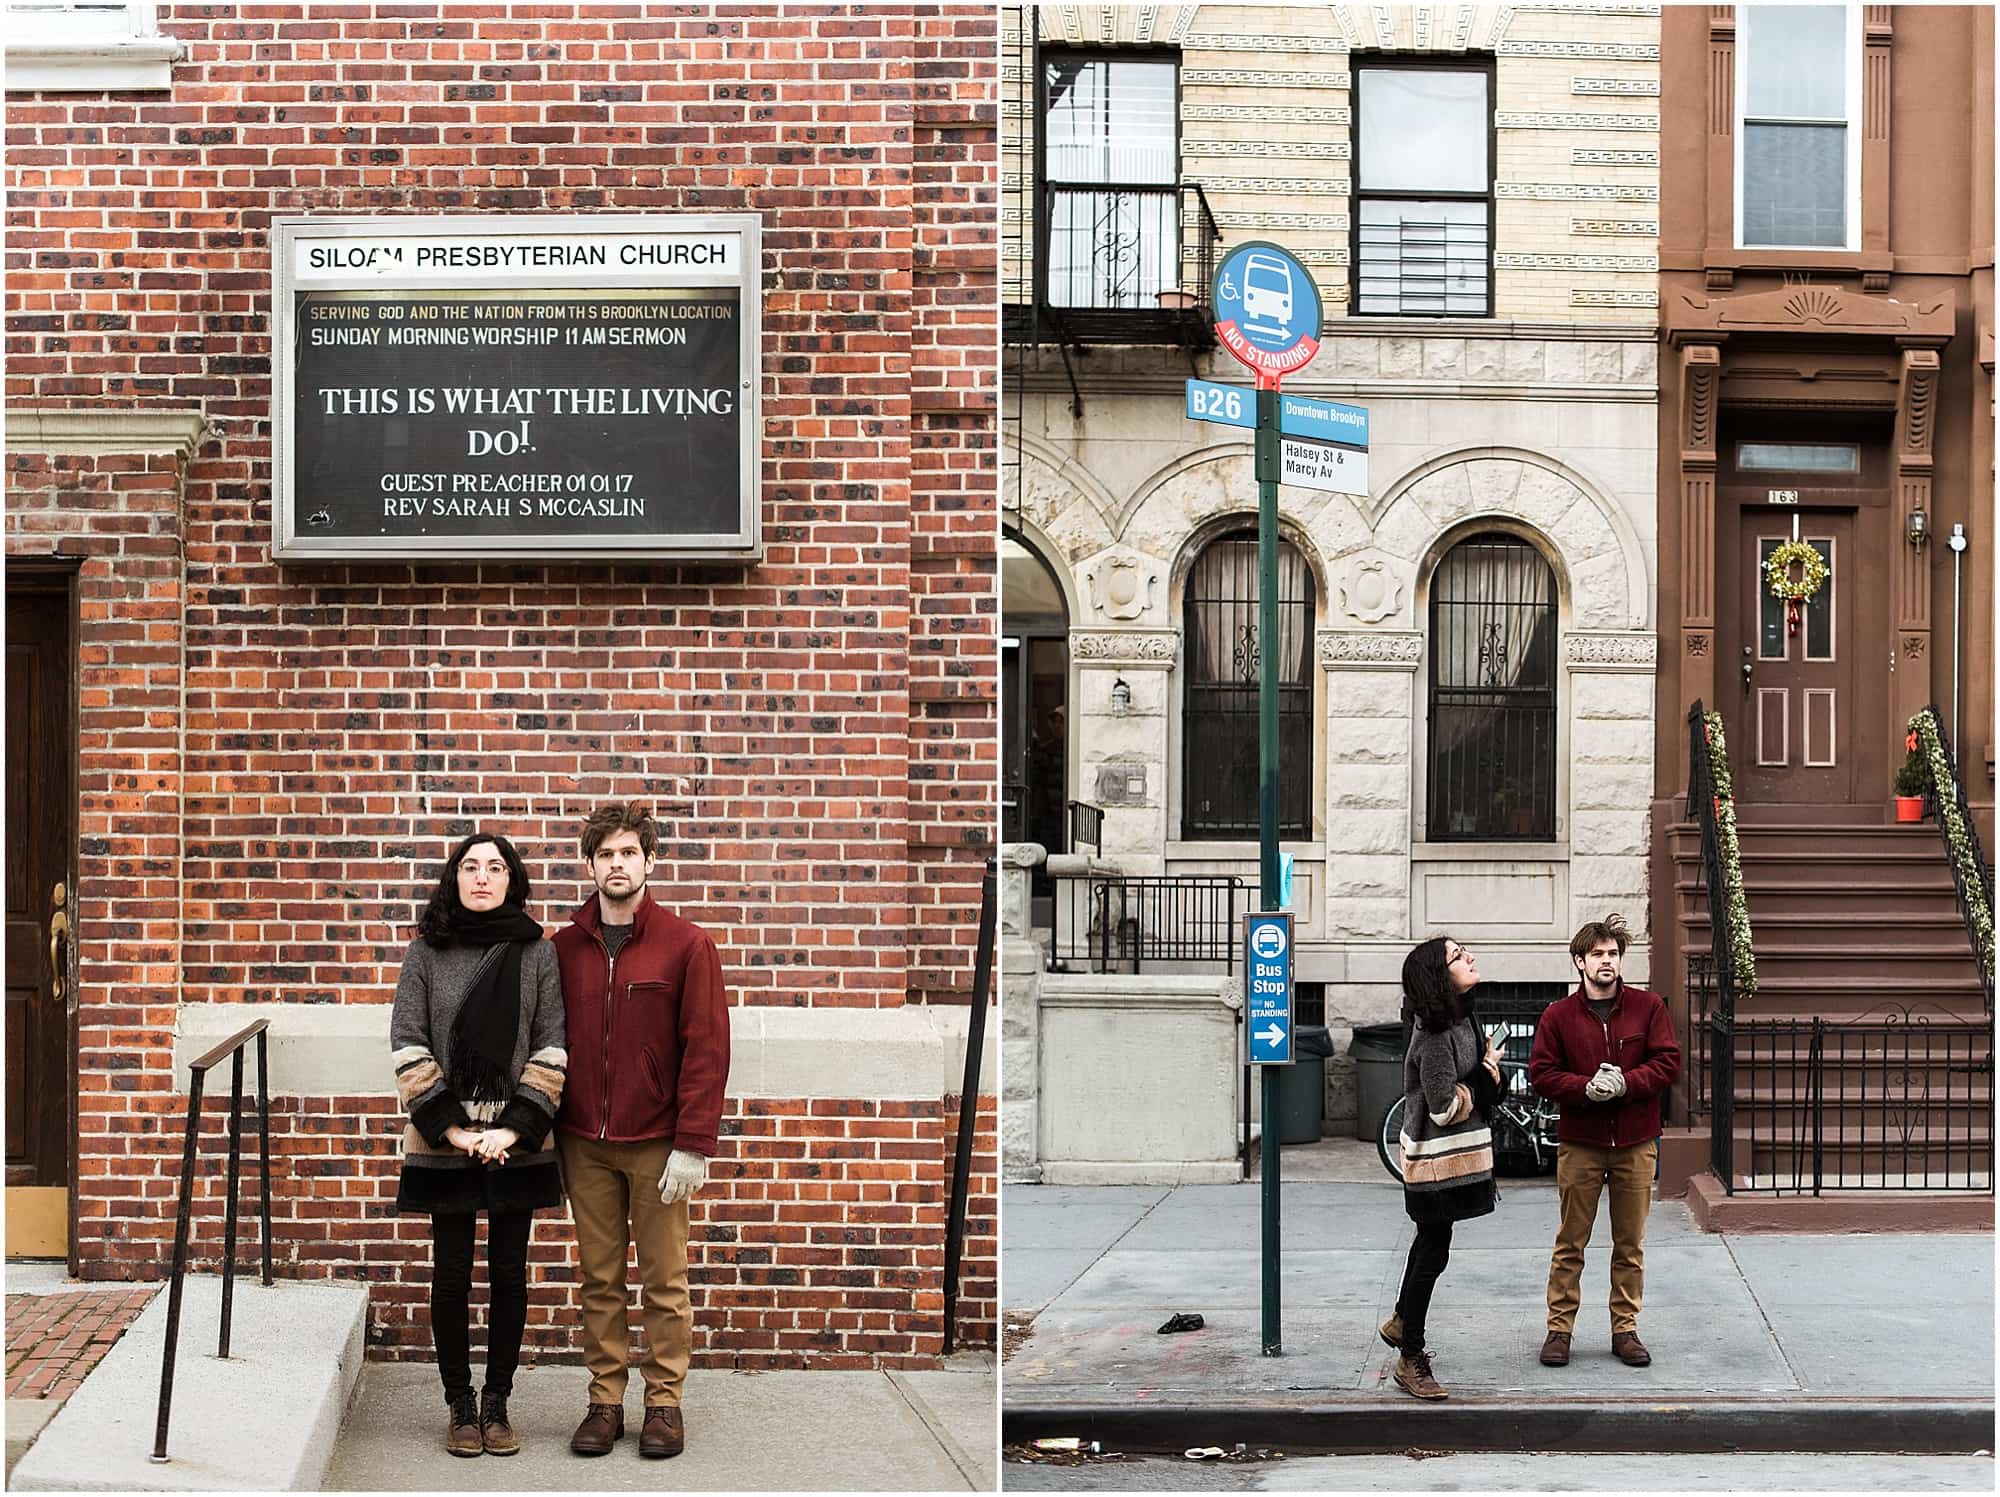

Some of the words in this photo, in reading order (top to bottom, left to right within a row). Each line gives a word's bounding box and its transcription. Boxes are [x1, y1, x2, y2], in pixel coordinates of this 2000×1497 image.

[417, 245, 606, 267] PRESBYTERIAN
[620, 244, 726, 265] CHURCH
[310, 305, 370, 320] SERVING
[378, 305, 404, 320] GOD
[409, 305, 439, 320] AND
[442, 305, 470, 319] THE
[474, 305, 524, 319] NATION
[528, 305, 566, 319] FROM
[601, 305, 669, 319] BROOKLYN
[671, 305, 732, 319] LOCATION
[311, 328, 381, 346] SUNDAY
[388, 327, 469, 345] MORNING
[472, 327, 558, 345] WORSHIP
[565, 327, 578, 344] 11
[582, 327, 606, 344] AM
[609, 327, 686, 344] SERMON
[1224, 327, 1245, 350] NO
[1246, 343, 1310, 368] STANDING
[319, 388, 398, 415] THIS
[407, 388, 436, 414] IS
[441, 388, 541, 414] WHAT
[546, 388, 616, 414] THE
[621, 388, 733, 415] LIVING
[1193, 388, 1242, 420] B26
[1285, 401, 1329, 421] Downtown
[1330, 408, 1366, 428] Brooklyn
[1286, 443, 1320, 463] Halsey
[1323, 449, 1333, 462] St
[1337, 452, 1345, 465] &
[1286, 459, 1317, 478] Marcy
[1320, 465, 1333, 478] Av
[380, 474, 447, 492] GUEST
[452, 474, 562, 492] PREACHER
[566, 474, 586, 492] 01
[590, 474, 610, 492] 01
[616, 474, 634, 492] 17
[1772, 490, 1796, 503] 163
[384, 498, 427, 516] REV
[432, 498, 510, 516] SARAH
[519, 498, 533, 516] S
[539, 498, 645, 516] MCCASLIN
[1256, 963, 1283, 977] Bus
[1253, 979, 1285, 996] Stop
[1251, 1009, 1288, 1018] STANDING
[1264, 1000, 1276, 1009] NO
